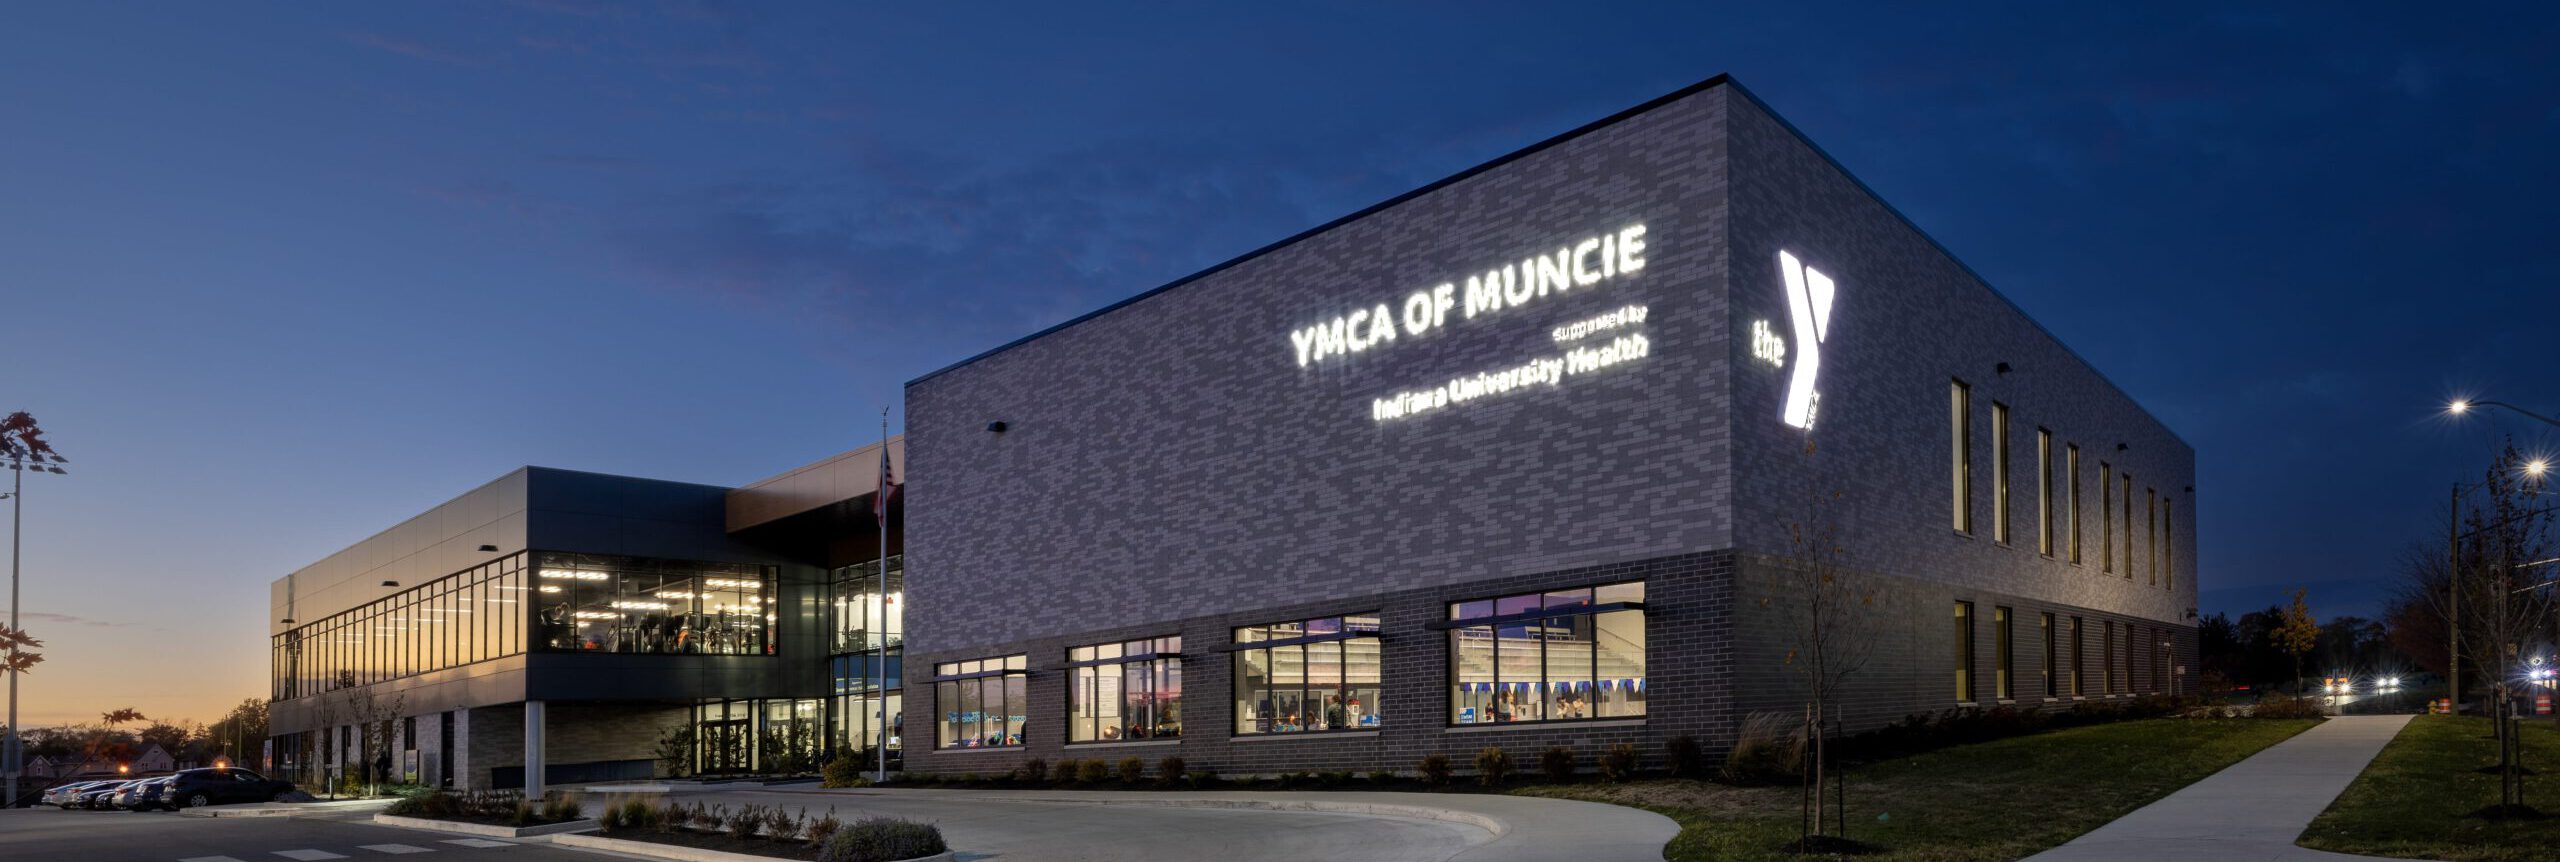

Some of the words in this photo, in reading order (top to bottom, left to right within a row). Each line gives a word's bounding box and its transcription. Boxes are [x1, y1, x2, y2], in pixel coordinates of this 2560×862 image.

[1291, 303, 1397, 367] YMCA
[1402, 282, 1455, 336] OF
[1463, 223, 1647, 319] MUNCIE
[1552, 307, 1626, 342] supported
[1628, 305, 1648, 323] by
[1753, 319, 1786, 367] the
[1777, 250, 1835, 428] Y
[1372, 385, 1448, 421] Indiana
[1449, 357, 1564, 402] University
[1566, 332, 1649, 375] Health
